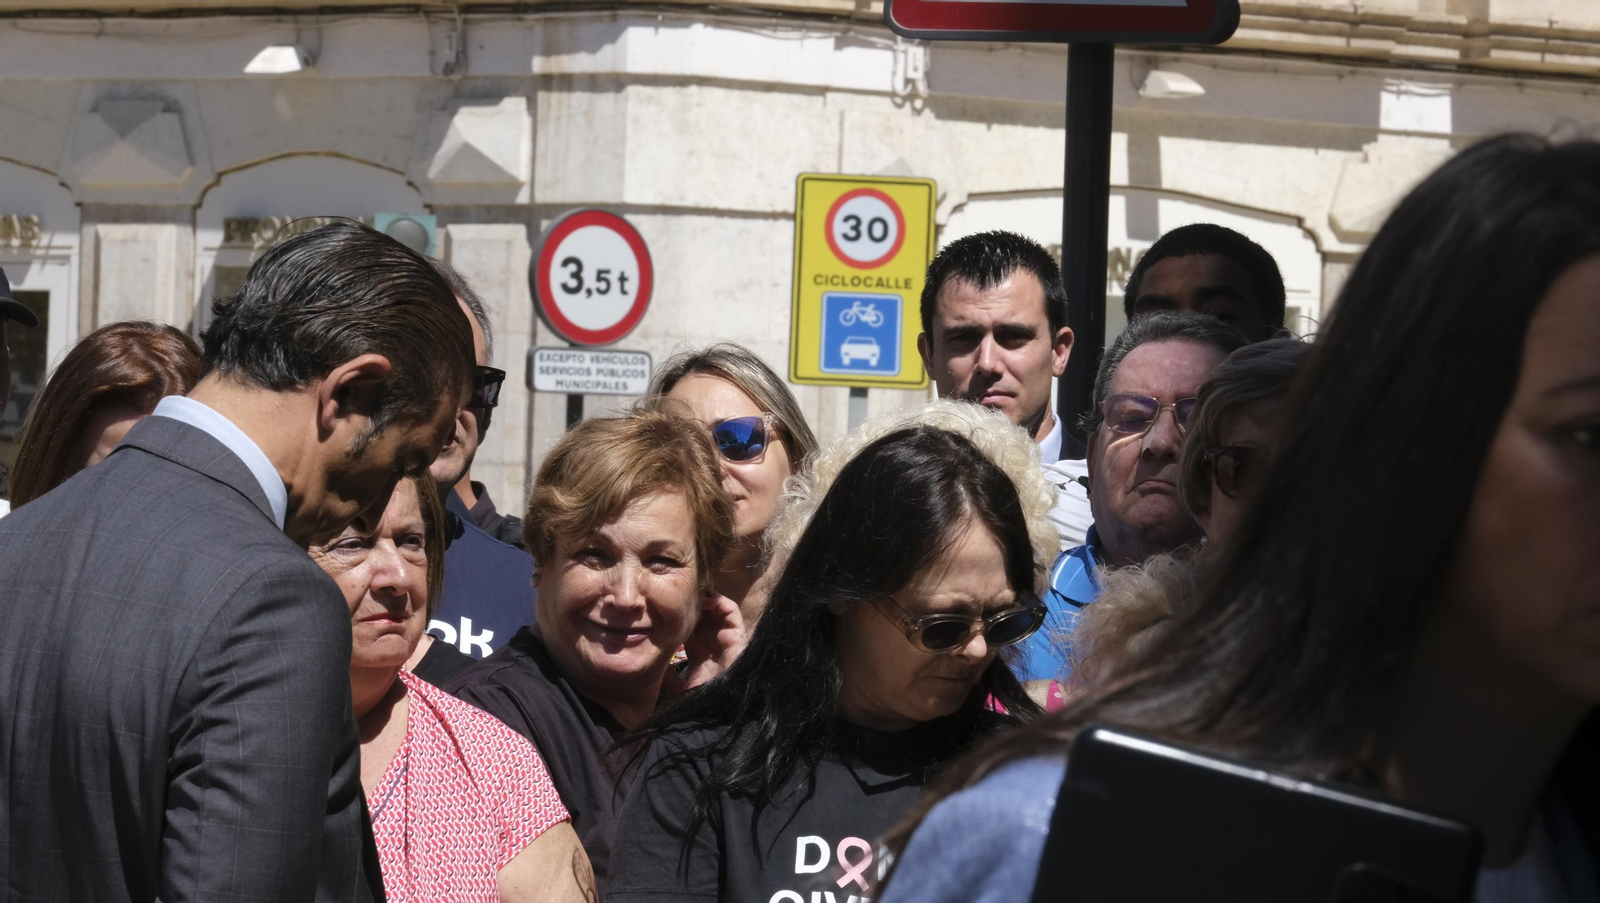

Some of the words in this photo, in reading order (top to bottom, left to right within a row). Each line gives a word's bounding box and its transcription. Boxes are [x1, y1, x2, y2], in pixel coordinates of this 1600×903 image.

[841, 215, 889, 243] 30
[560, 256, 611, 299] 3,5
[617, 270, 629, 295] t
[813, 273, 913, 290] CICLOCALLE
[539, 353, 585, 363] EXCEPTO
[589, 354, 646, 365] VEHÍCULOS
[539, 366, 591, 376] SERVICIOS
[596, 367, 646, 378] PÚBLICOS
[555, 380, 628, 391] MUNICIPALES
